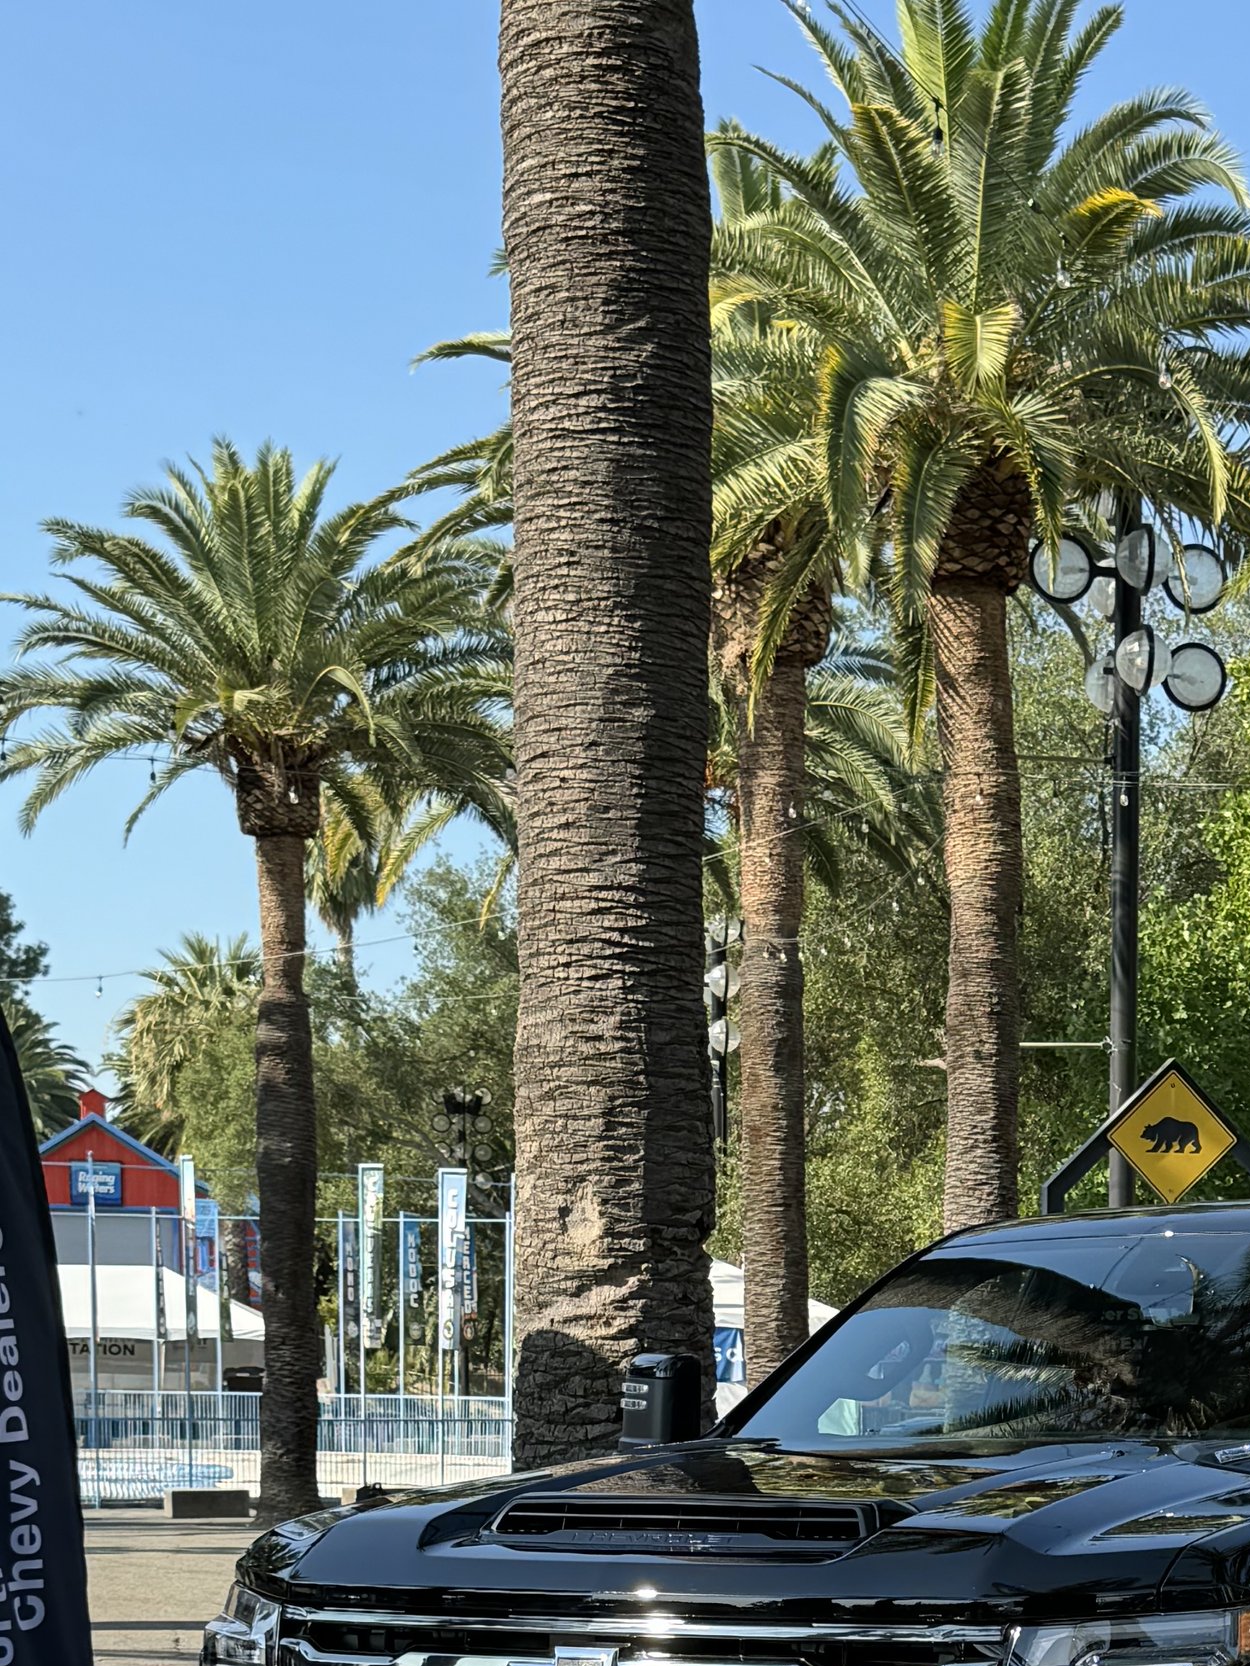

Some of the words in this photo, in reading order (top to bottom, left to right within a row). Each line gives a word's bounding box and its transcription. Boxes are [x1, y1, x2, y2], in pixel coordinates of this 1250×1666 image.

[407, 1232, 420, 1308] MODOC
[0, 1227, 30, 1443] Deale
[69, 1342, 136, 1356] TAION
[8, 1459, 46, 1632] Chevy
